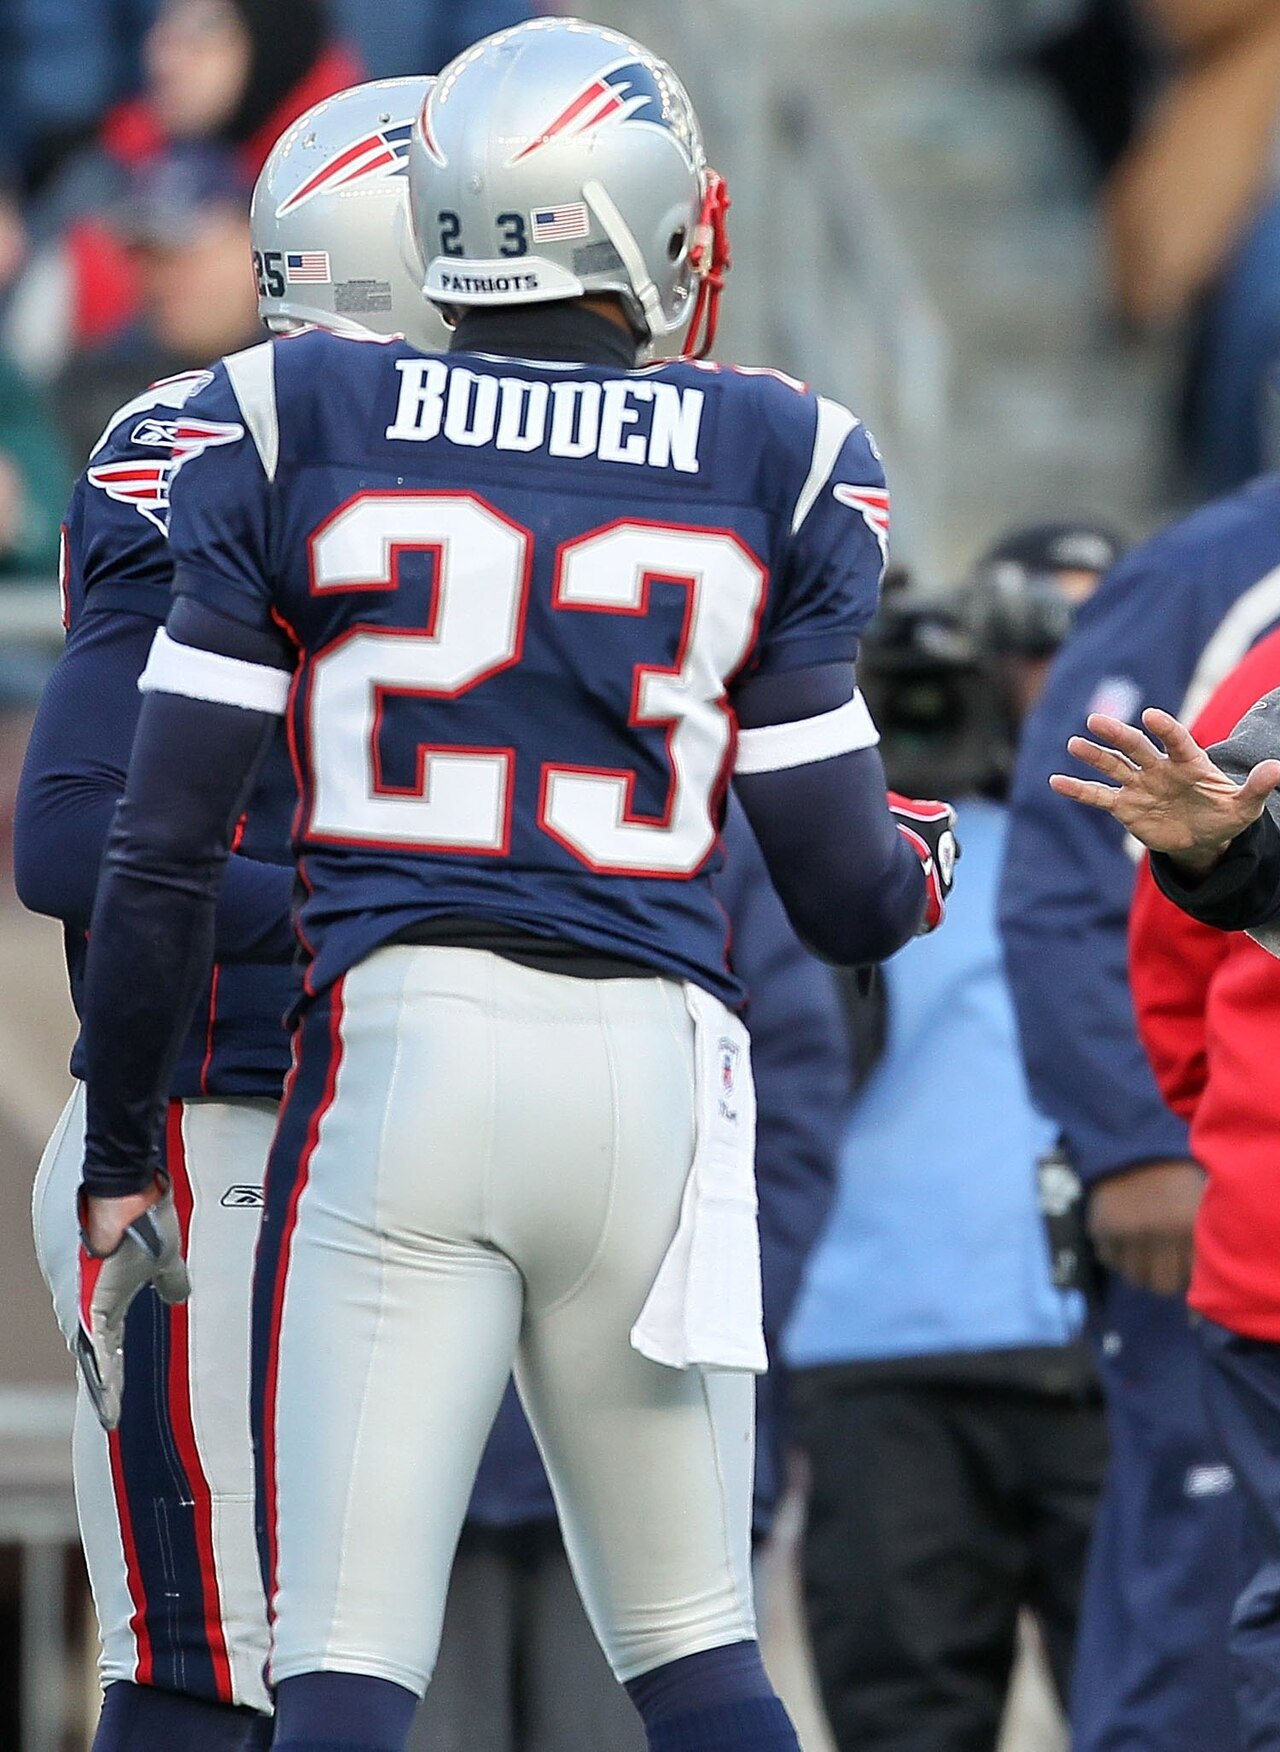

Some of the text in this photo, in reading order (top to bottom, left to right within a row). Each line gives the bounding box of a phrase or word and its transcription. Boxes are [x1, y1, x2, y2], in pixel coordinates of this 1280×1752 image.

[438, 212, 528, 257] 2 3
[441, 274, 537, 292] PATRIOTS
[385, 358, 705, 474] BODDEN
[305, 489, 770, 880] 23
